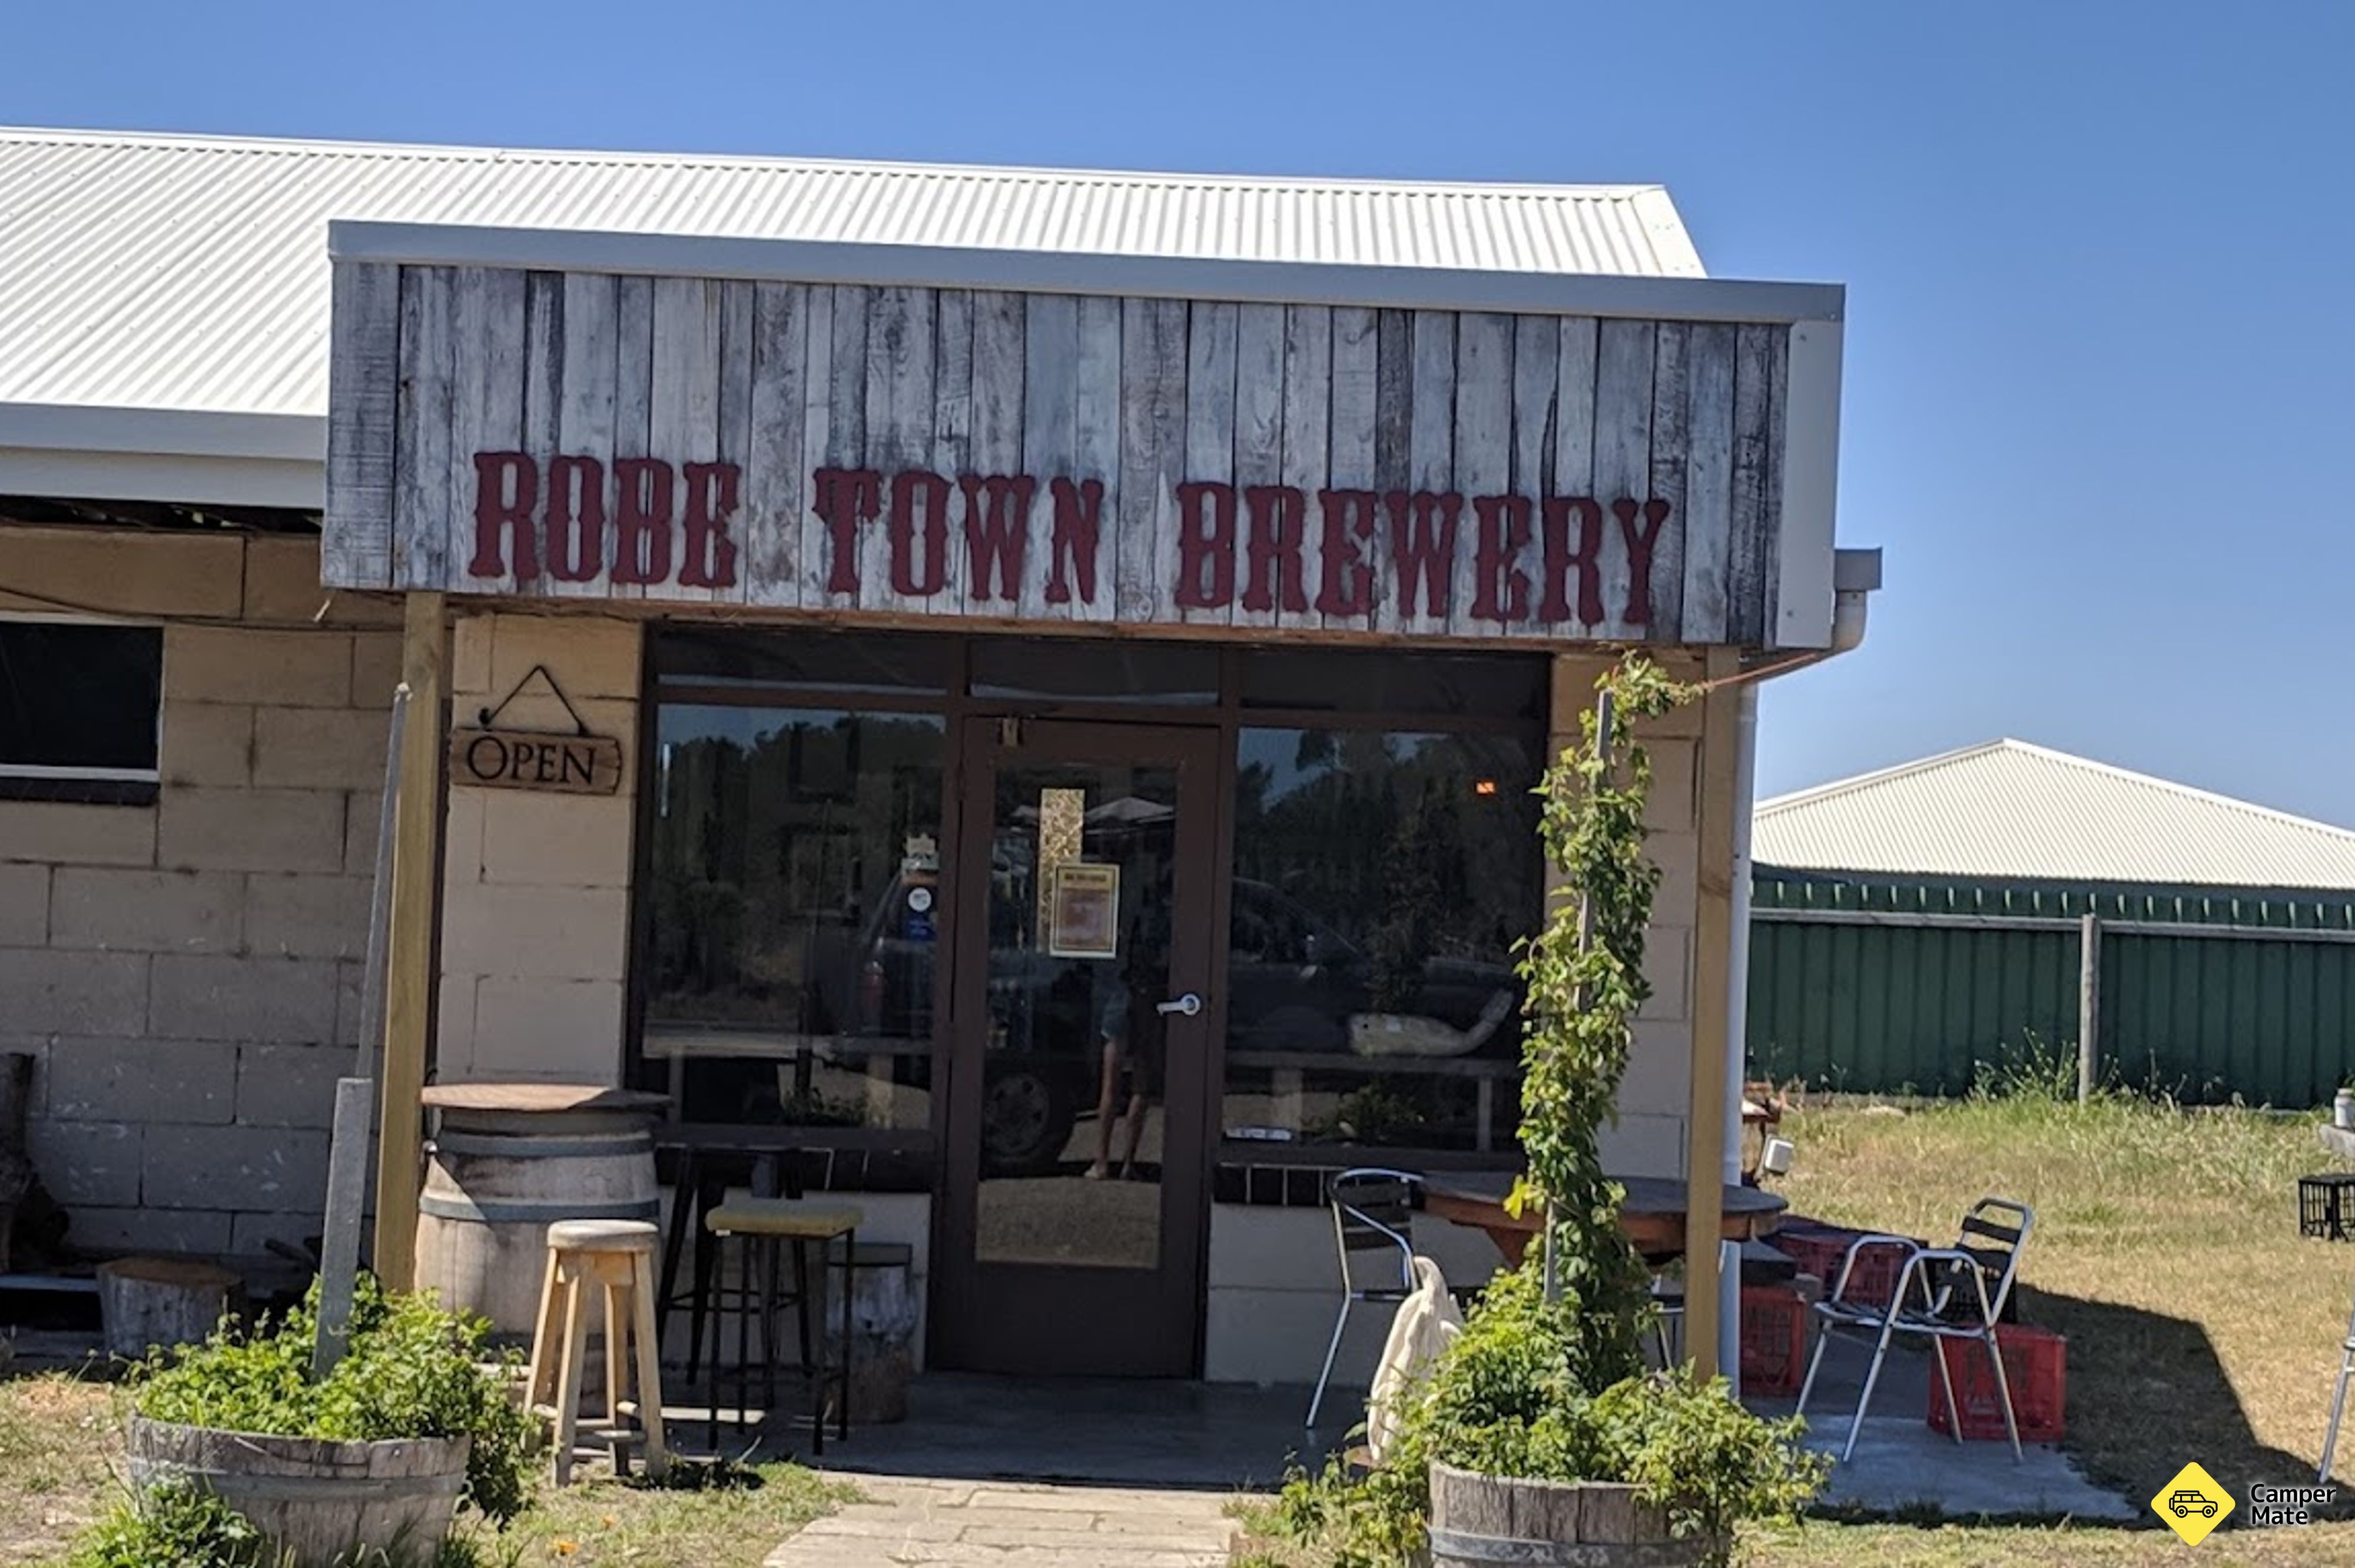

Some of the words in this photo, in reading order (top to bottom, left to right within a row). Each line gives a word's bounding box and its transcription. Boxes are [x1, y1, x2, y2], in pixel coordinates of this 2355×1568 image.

[468, 451, 741, 588] ROBE
[812, 467, 1104, 604] TOWN
[1176, 481, 1671, 624] BREWERY
[467, 736, 596, 784] OPEN
